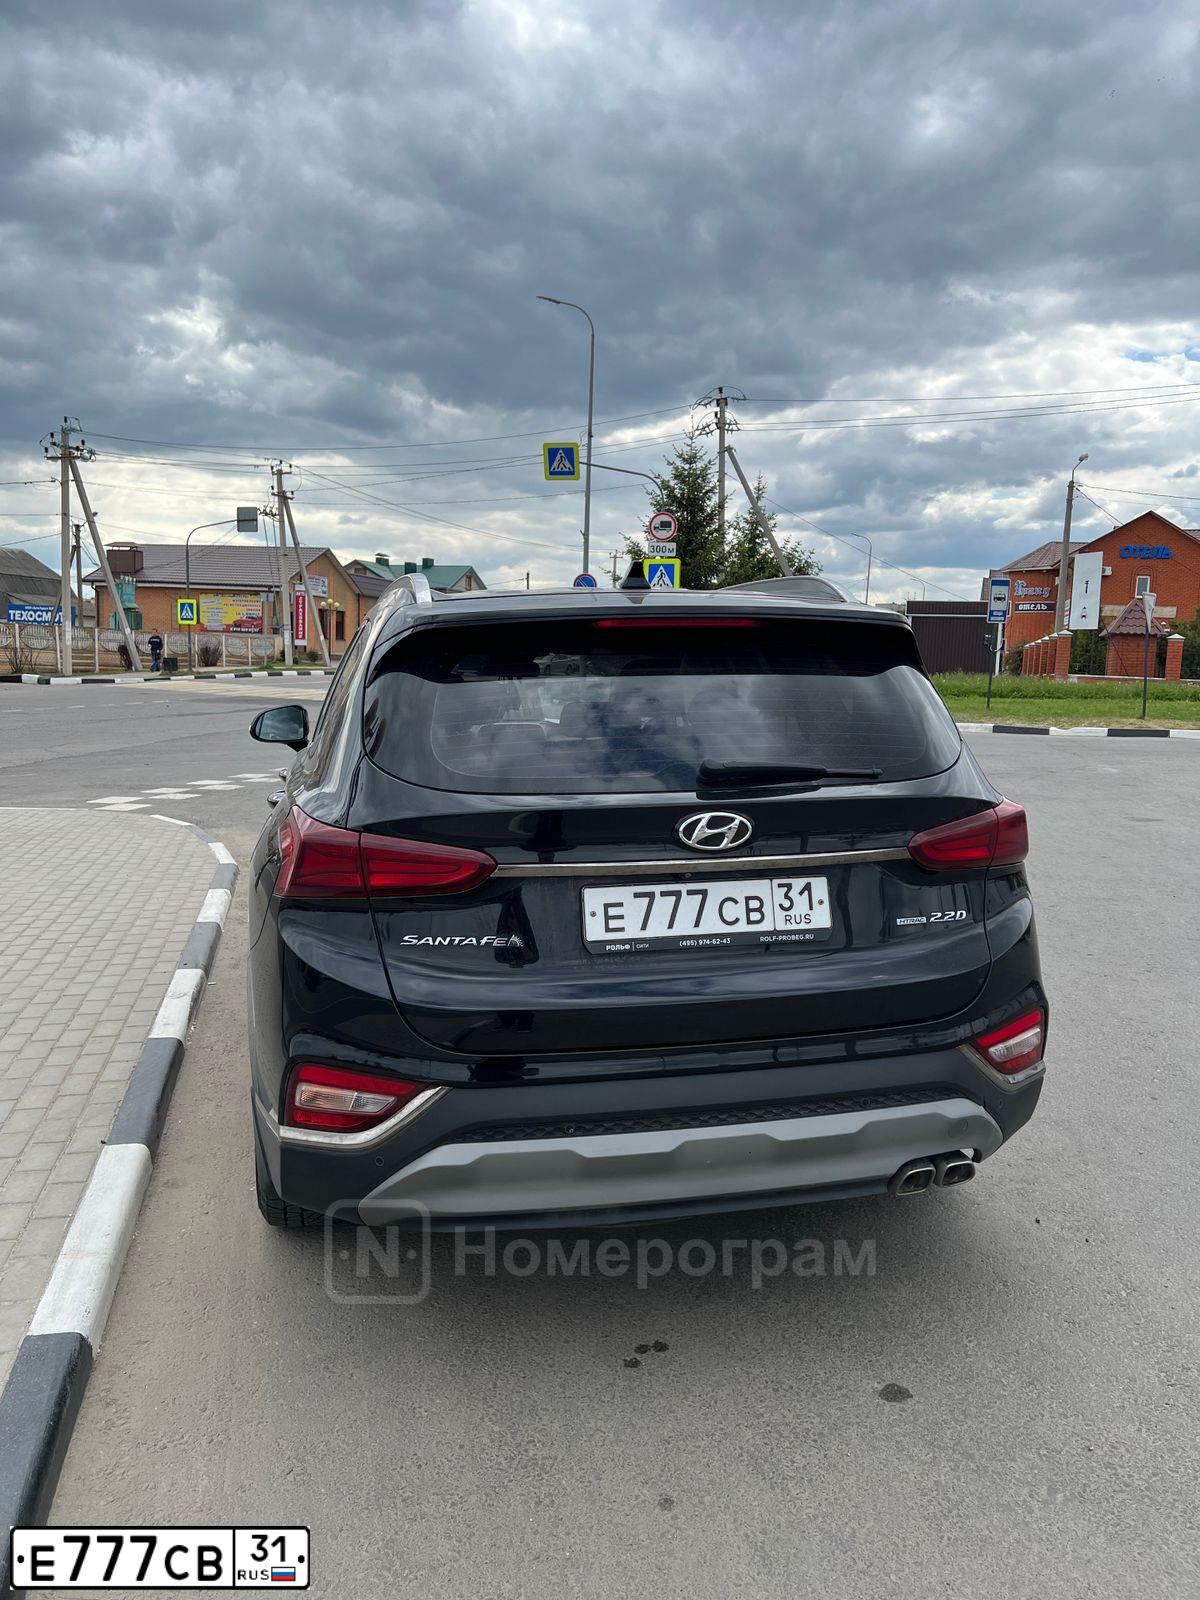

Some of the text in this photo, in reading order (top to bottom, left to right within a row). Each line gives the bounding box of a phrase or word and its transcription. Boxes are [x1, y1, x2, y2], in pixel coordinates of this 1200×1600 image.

[1120, 544, 1173, 560] ОТЕЛЬ
[603, 881, 814, 933] Е777СВ 31
[784, 914, 812, 925] RUS
[698, 938, 731, 946] 974-62-43
[759, 933, 815, 942] ROLF-PROBEG.RU
